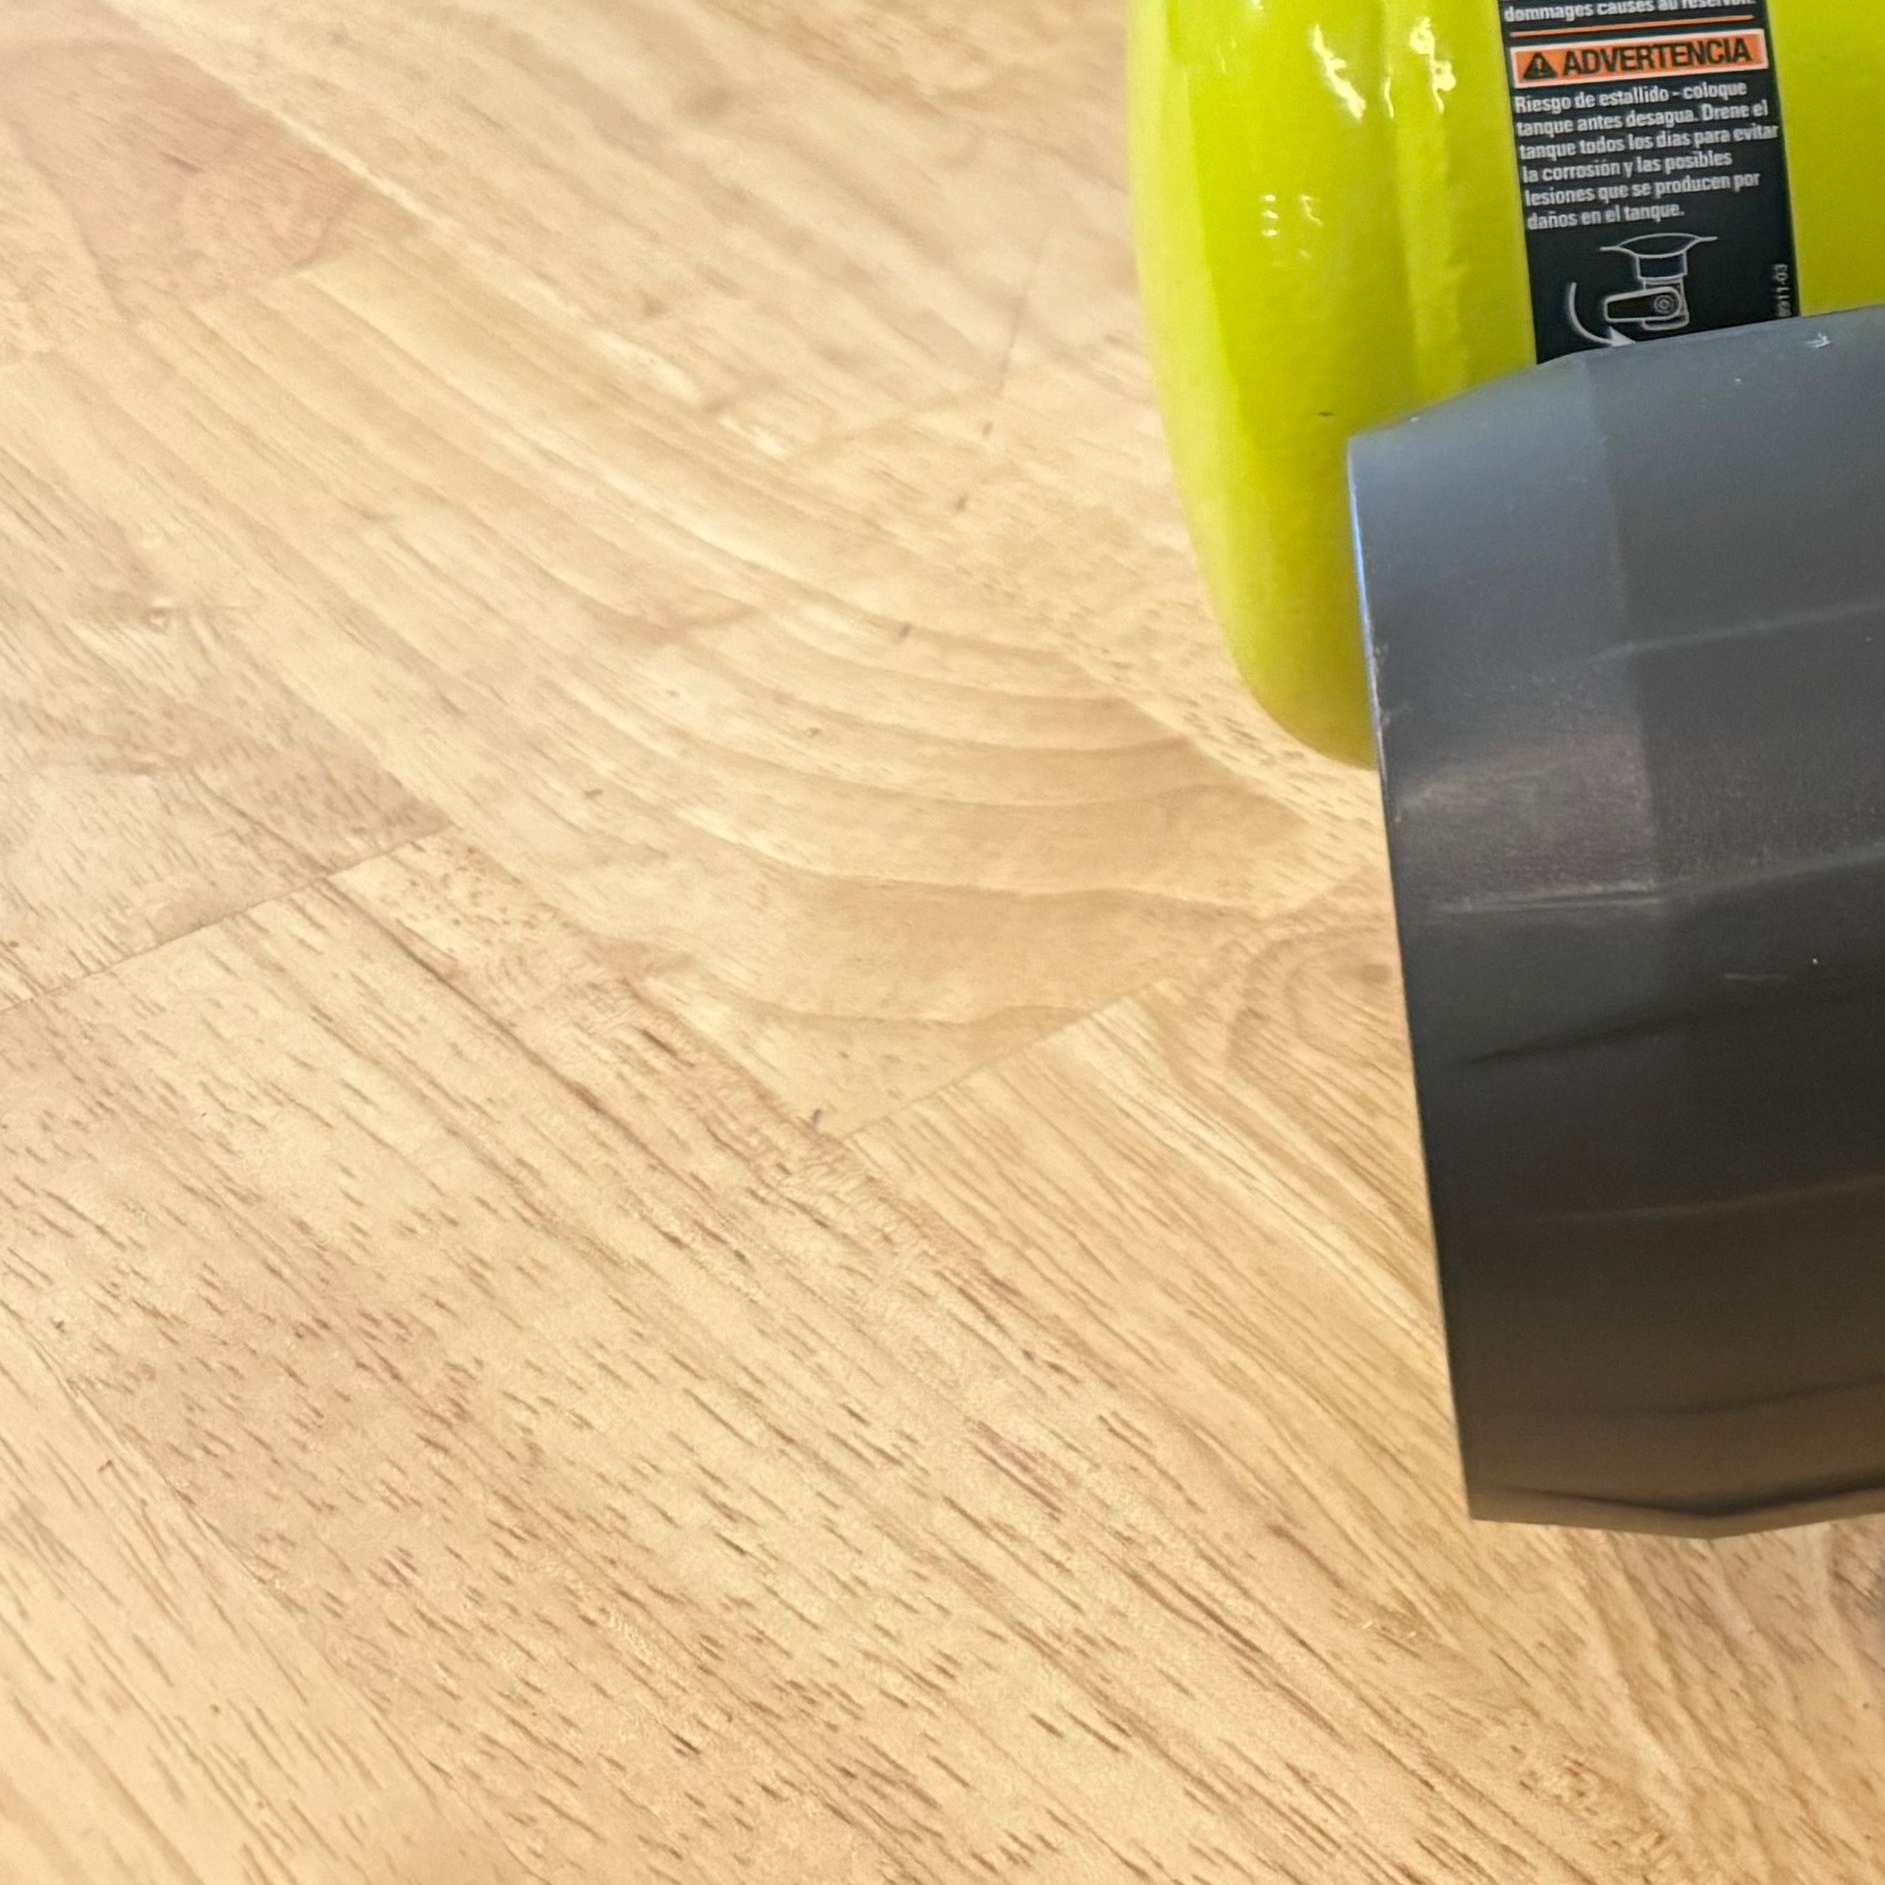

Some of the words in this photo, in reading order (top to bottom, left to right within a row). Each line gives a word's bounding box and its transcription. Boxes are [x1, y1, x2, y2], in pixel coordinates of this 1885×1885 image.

[1562, 38, 1752, 75] ADVERTENCIA
[1524, 186, 1595, 206] lesiones
[1599, 184, 1629, 204] que
[1632, 181, 1651, 196] se
[1655, 174, 1731, 195] producen
[1734, 172, 1761, 193] por
[1526, 210, 1578, 230] daños
[1582, 209, 1602, 224] en
[1605, 204, 1622, 222] el
[1624, 202, 1685, 223] tanque.
